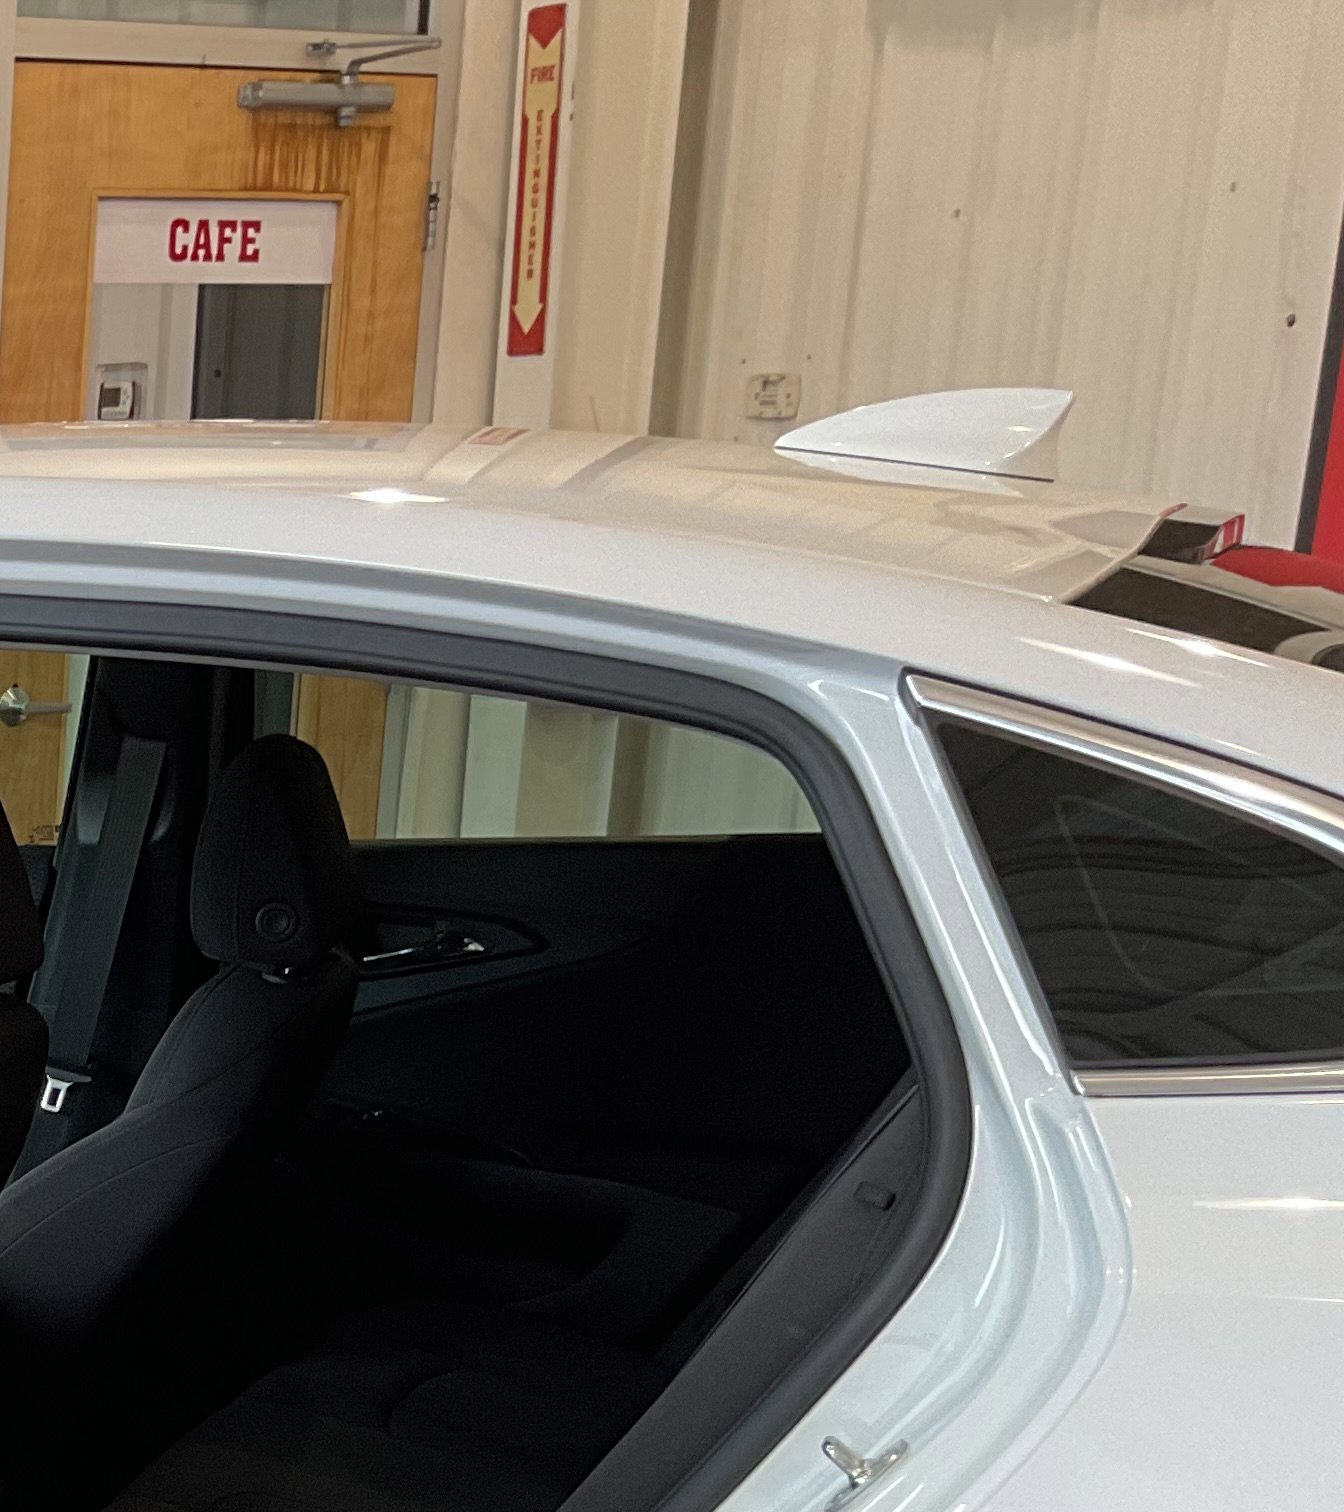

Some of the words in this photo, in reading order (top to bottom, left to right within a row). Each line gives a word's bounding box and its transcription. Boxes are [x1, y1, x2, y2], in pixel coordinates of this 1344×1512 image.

[531, 65, 556, 84] FIRE
[526, 109, 544, 281] EXTINGUISHER
[168, 218, 262, 262] CAFE
